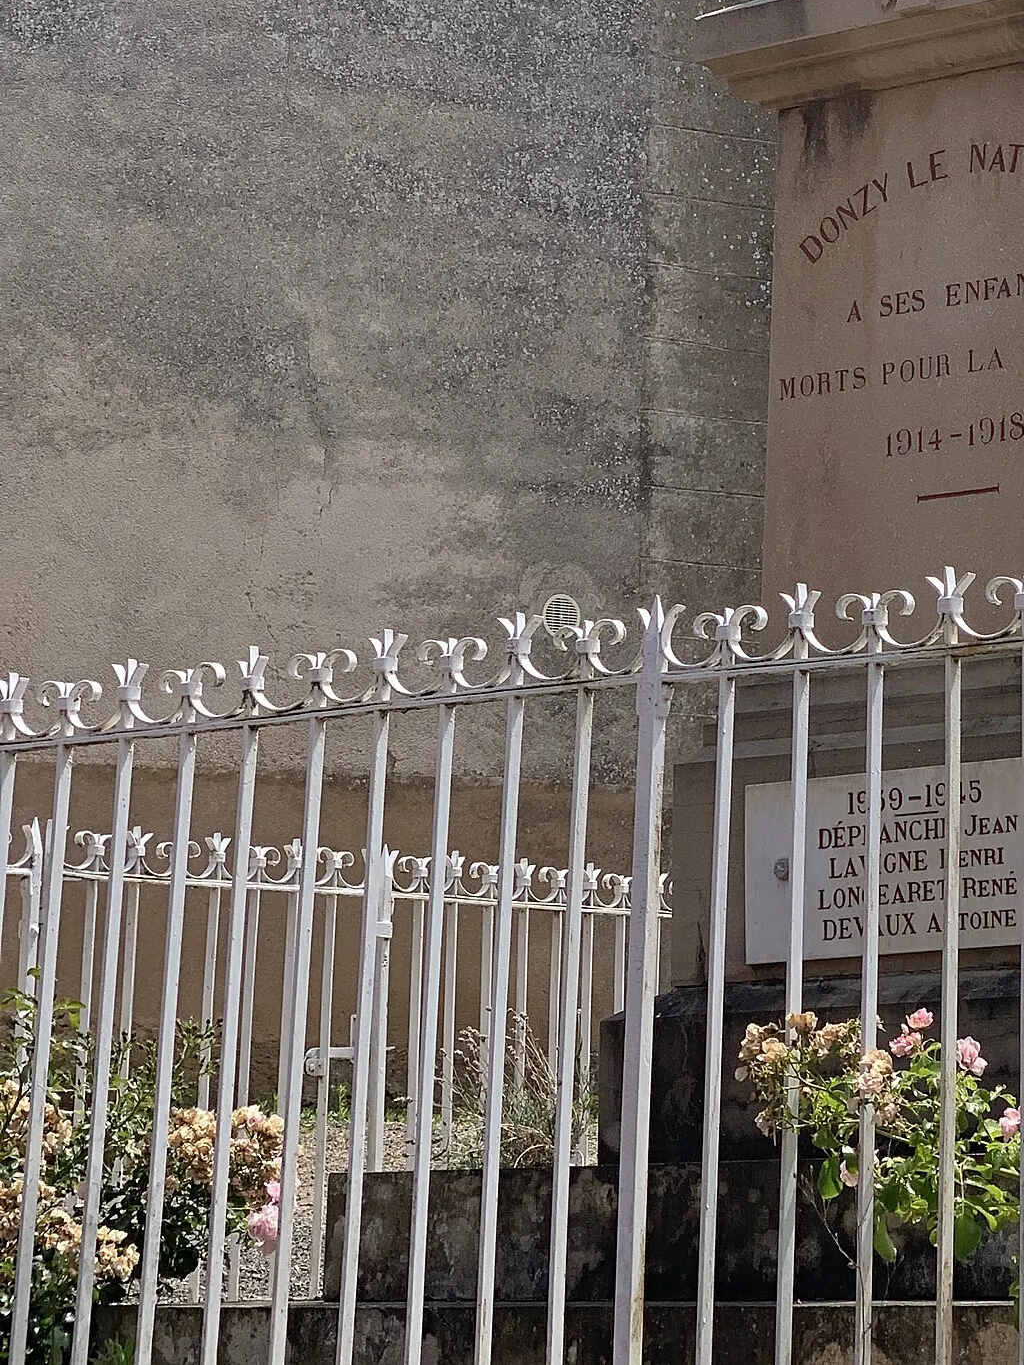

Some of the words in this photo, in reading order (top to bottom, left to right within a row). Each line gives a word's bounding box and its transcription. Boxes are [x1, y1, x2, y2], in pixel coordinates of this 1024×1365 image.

[799, 172, 890, 264] DONZY
[906, 149, 949, 190] LE
[846, 300, 863, 324] A
[879, 289, 926, 319] SES
[780, 367, 867, 401] MORTS
[882, 354, 951, 386] POUR
[967, 348, 1005, 374] LA
[965, 815, 1018, 836] JEAN
[962, 871, 1017, 898] RENÉ
[927, 909, 1017, 933] ATOINE
